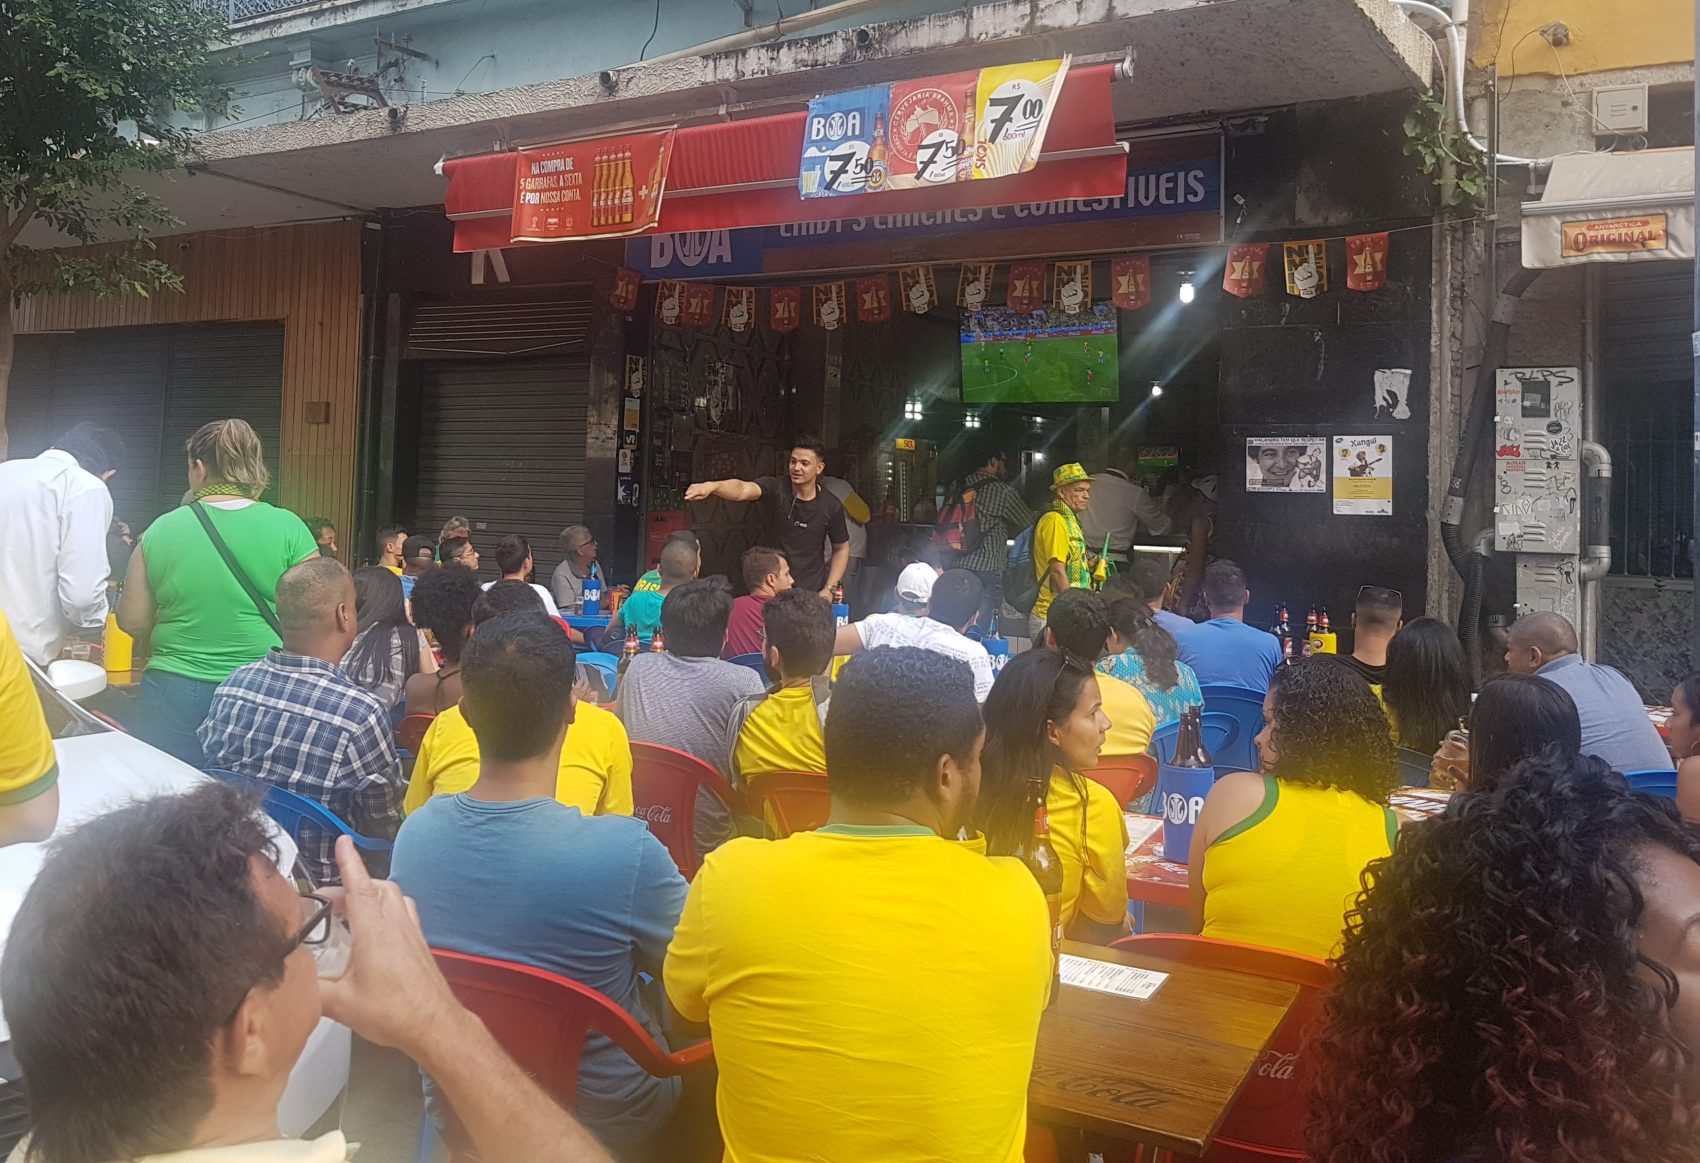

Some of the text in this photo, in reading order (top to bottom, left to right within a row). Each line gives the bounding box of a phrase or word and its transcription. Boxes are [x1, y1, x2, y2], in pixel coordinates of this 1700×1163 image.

[893, 92, 955, 126] CERVEJARIA BRAHMA
[811, 111, 861, 141] BOA
[975, 138, 988, 170] SKOL
[531, 157, 574, 175] NA COMPRA DE
[519, 178, 526, 190] 5
[559, 174, 564, 187] A
[564, 172, 583, 187] SEXTA
[525, 192, 540, 205] POR
[540, 190, 561, 205] NOSSA
[1594, 221, 1642, 230] ANTARCTICA
[1572, 229, 1656, 252] ORIGINAL
[1350, 437, 1377, 447] Xangai
